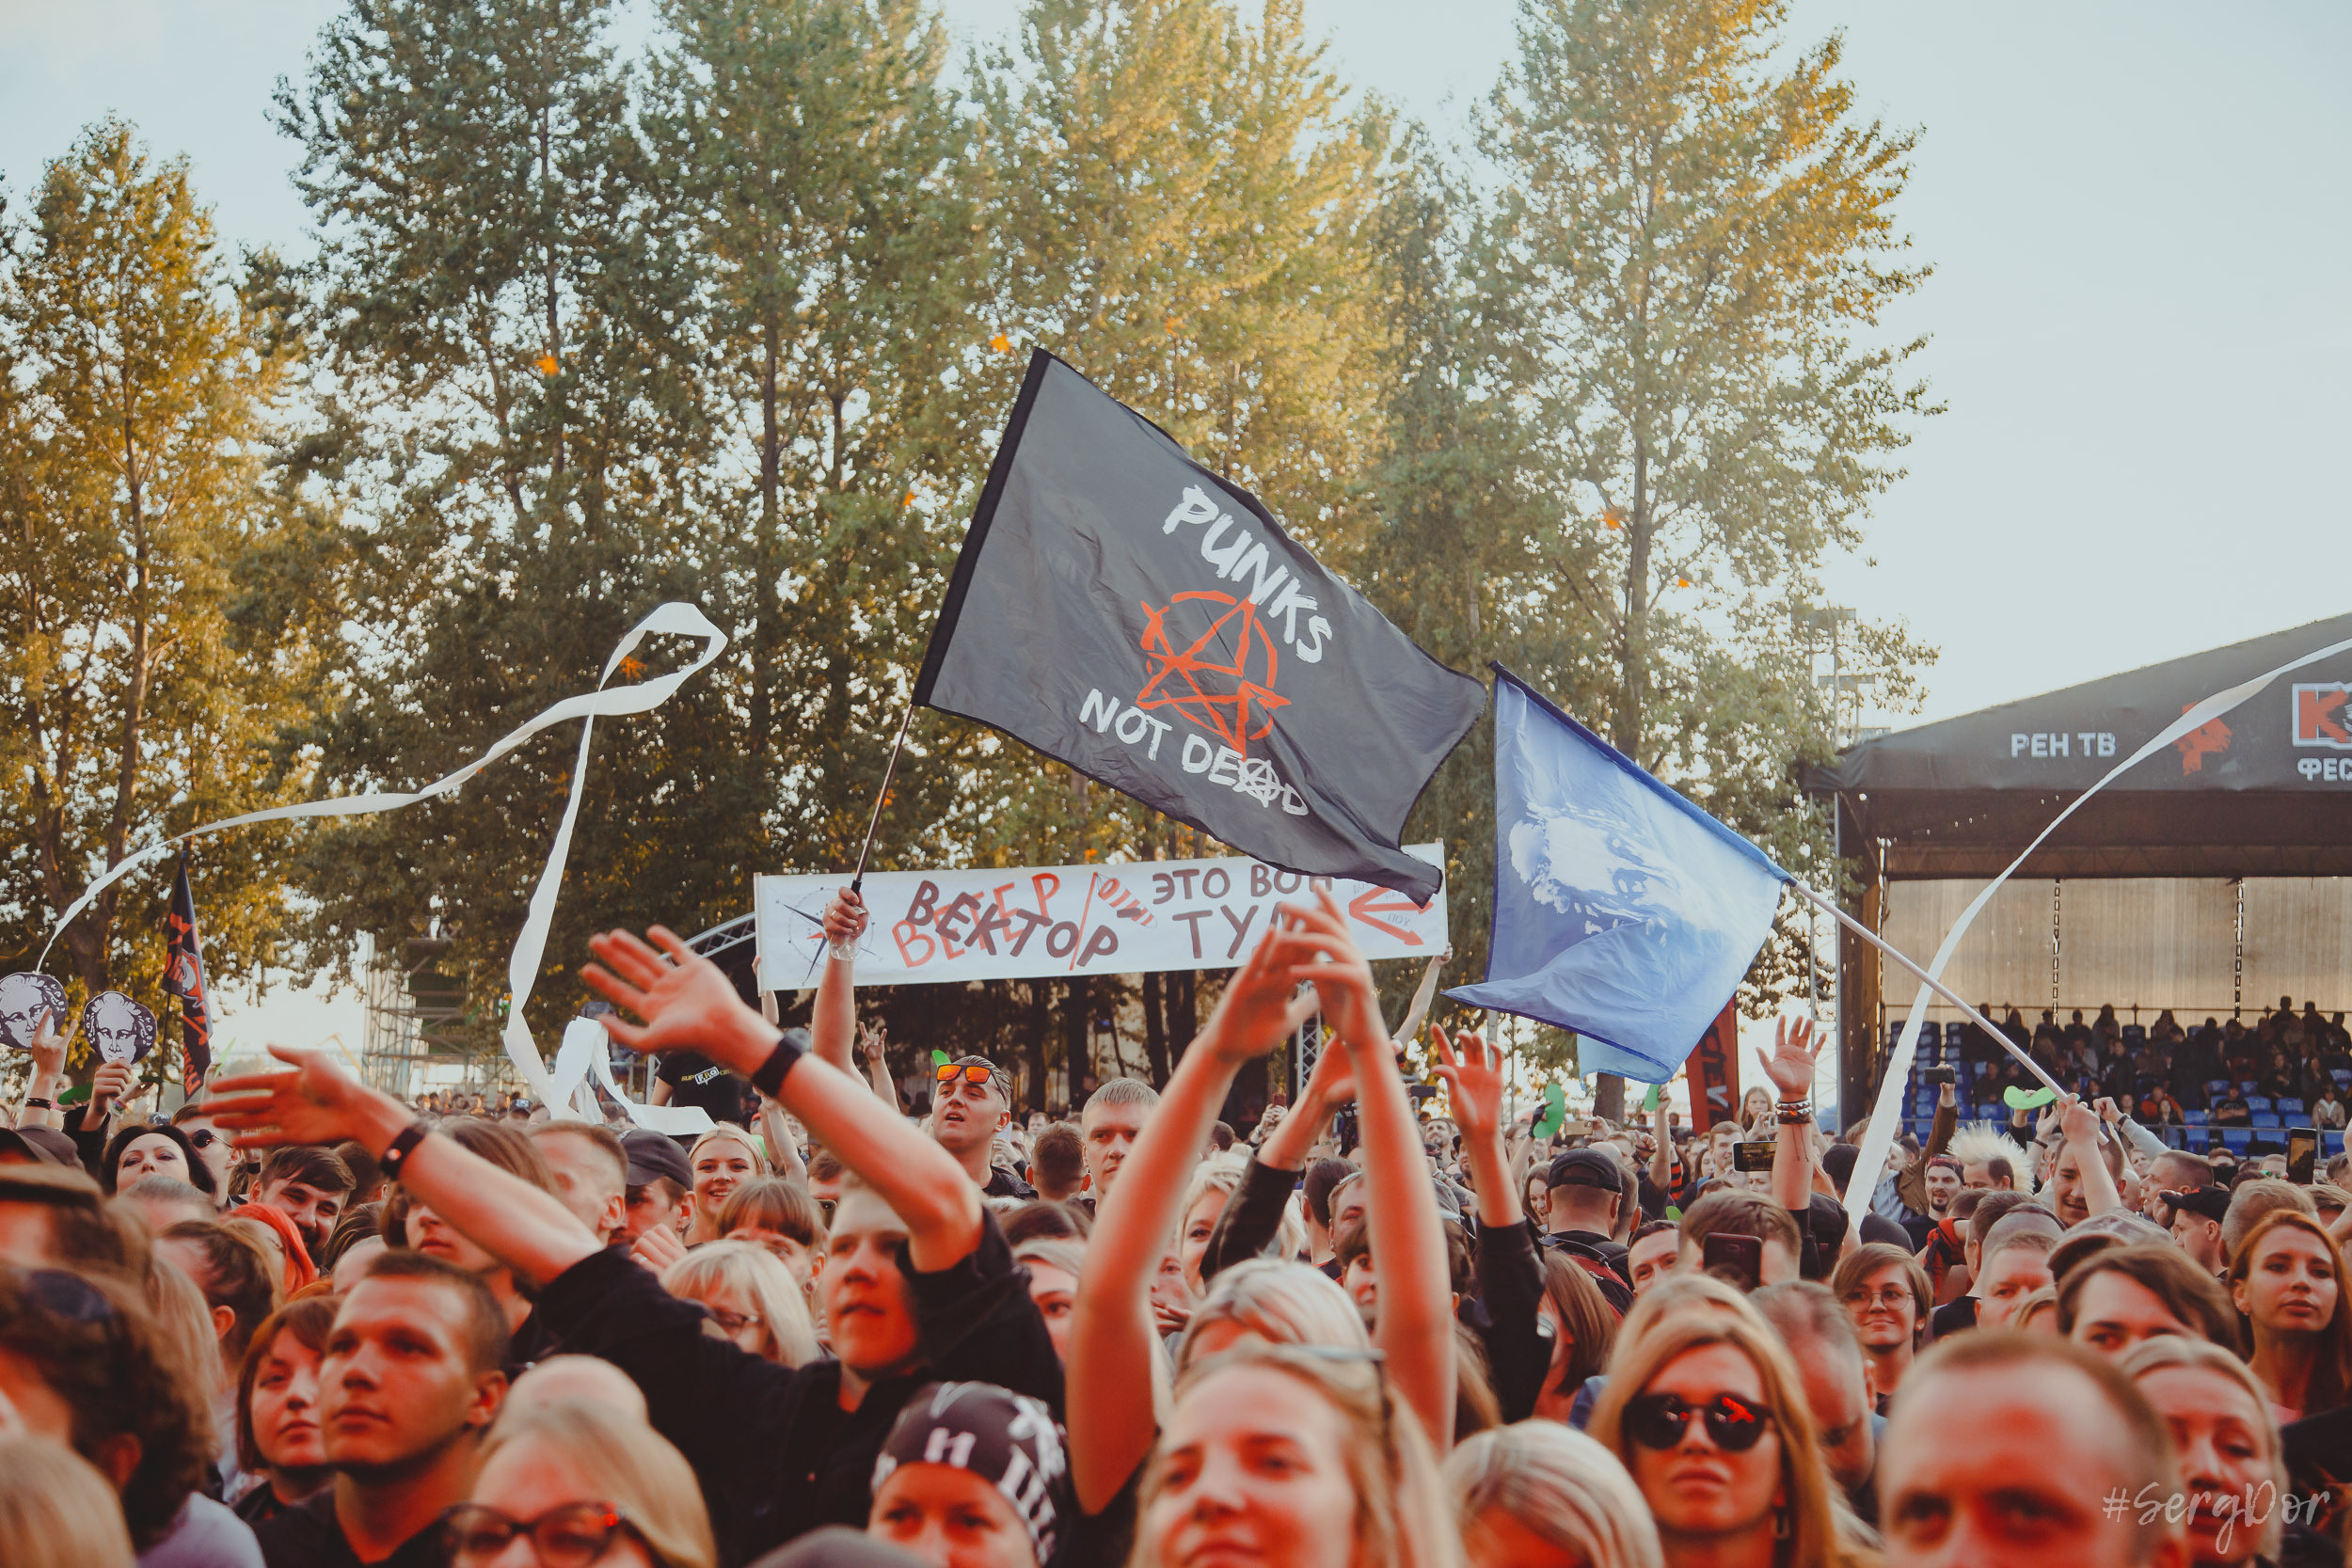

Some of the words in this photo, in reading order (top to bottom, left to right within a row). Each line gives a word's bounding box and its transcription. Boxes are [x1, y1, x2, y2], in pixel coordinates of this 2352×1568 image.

[1162, 483, 1333, 664] PUNKS
[1078, 688, 1172, 761] NOT
[2010, 733, 2070, 758] РЕН
[2077, 732, 2117, 757] ТВ
[1152, 867, 1231, 904] ЭТО
[905, 879, 1120, 968] ВЕКТОР
